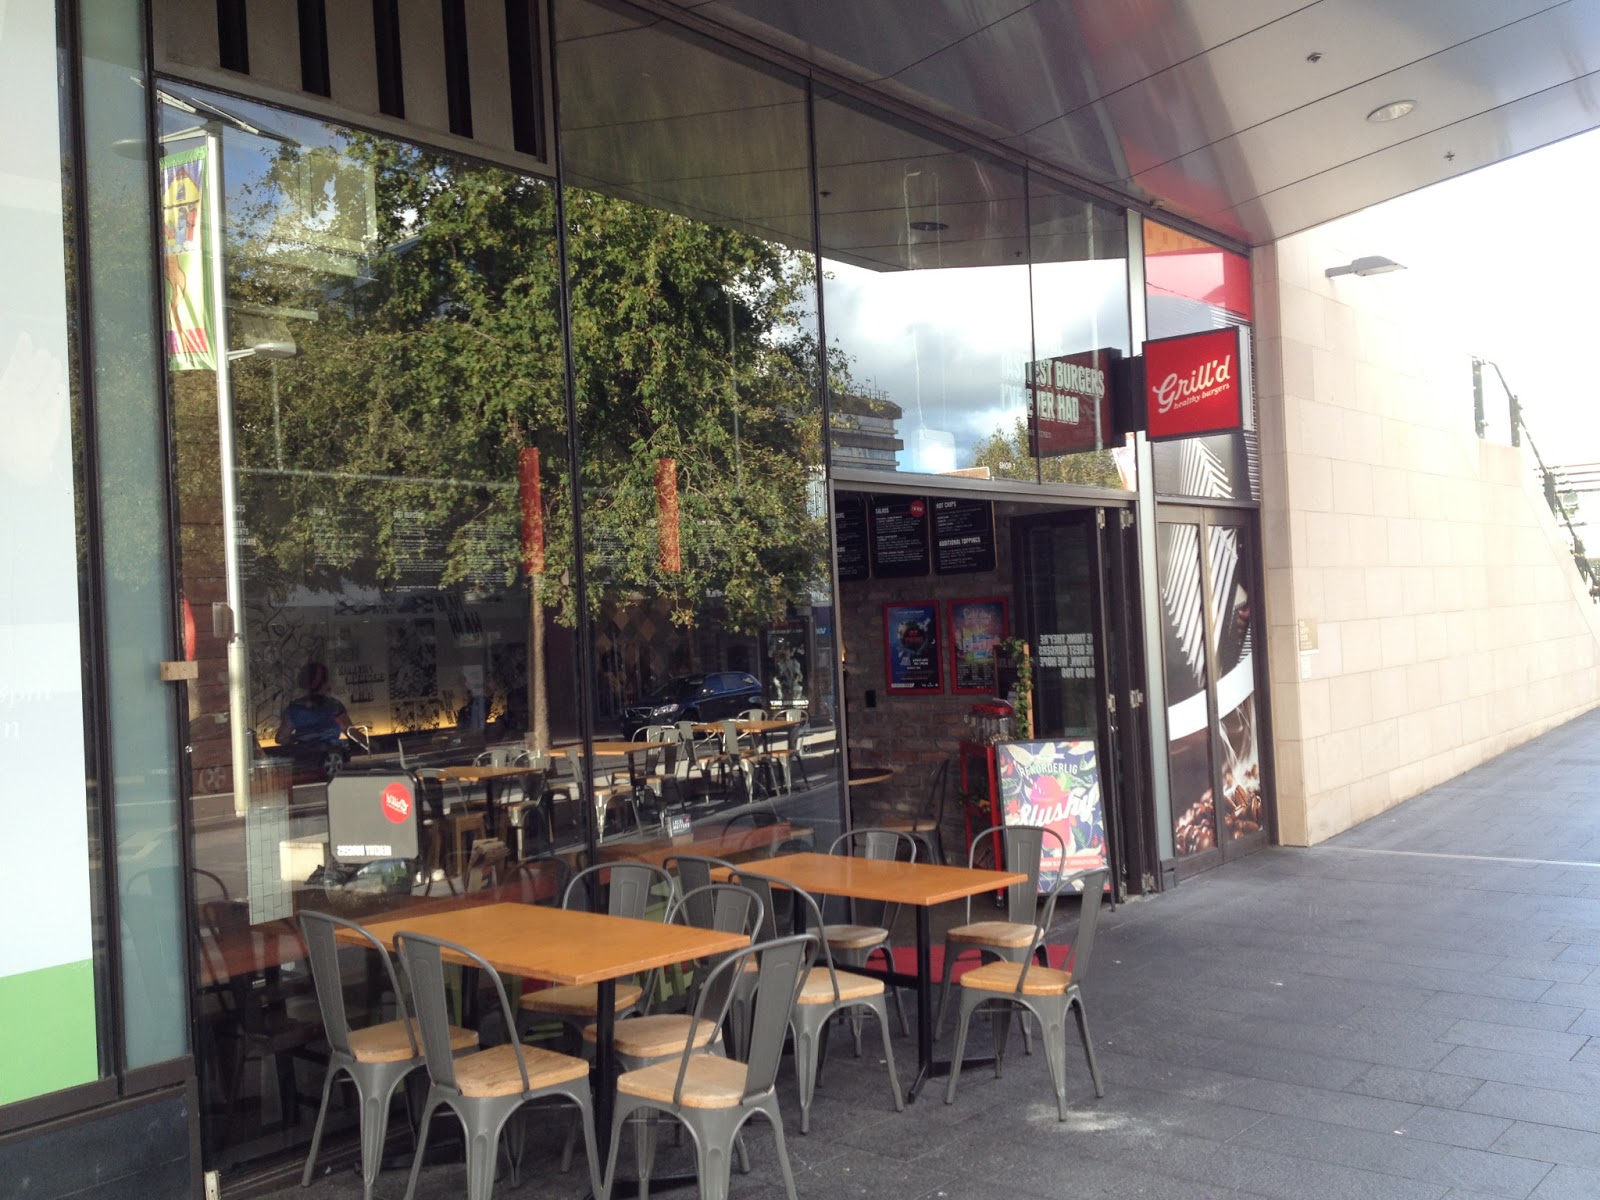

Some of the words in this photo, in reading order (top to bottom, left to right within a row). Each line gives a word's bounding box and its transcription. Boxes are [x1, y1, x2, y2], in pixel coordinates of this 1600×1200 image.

[1055, 361, 1105, 400] BURGERS
[1152, 354, 1231, 414] Grill'd
[1057, 395, 1080, 425] HAD
[1173, 393, 1201, 410] healthy
[1201, 383, 1230, 399] burgers
[1019, 762, 1079, 777] REKORDERLIG
